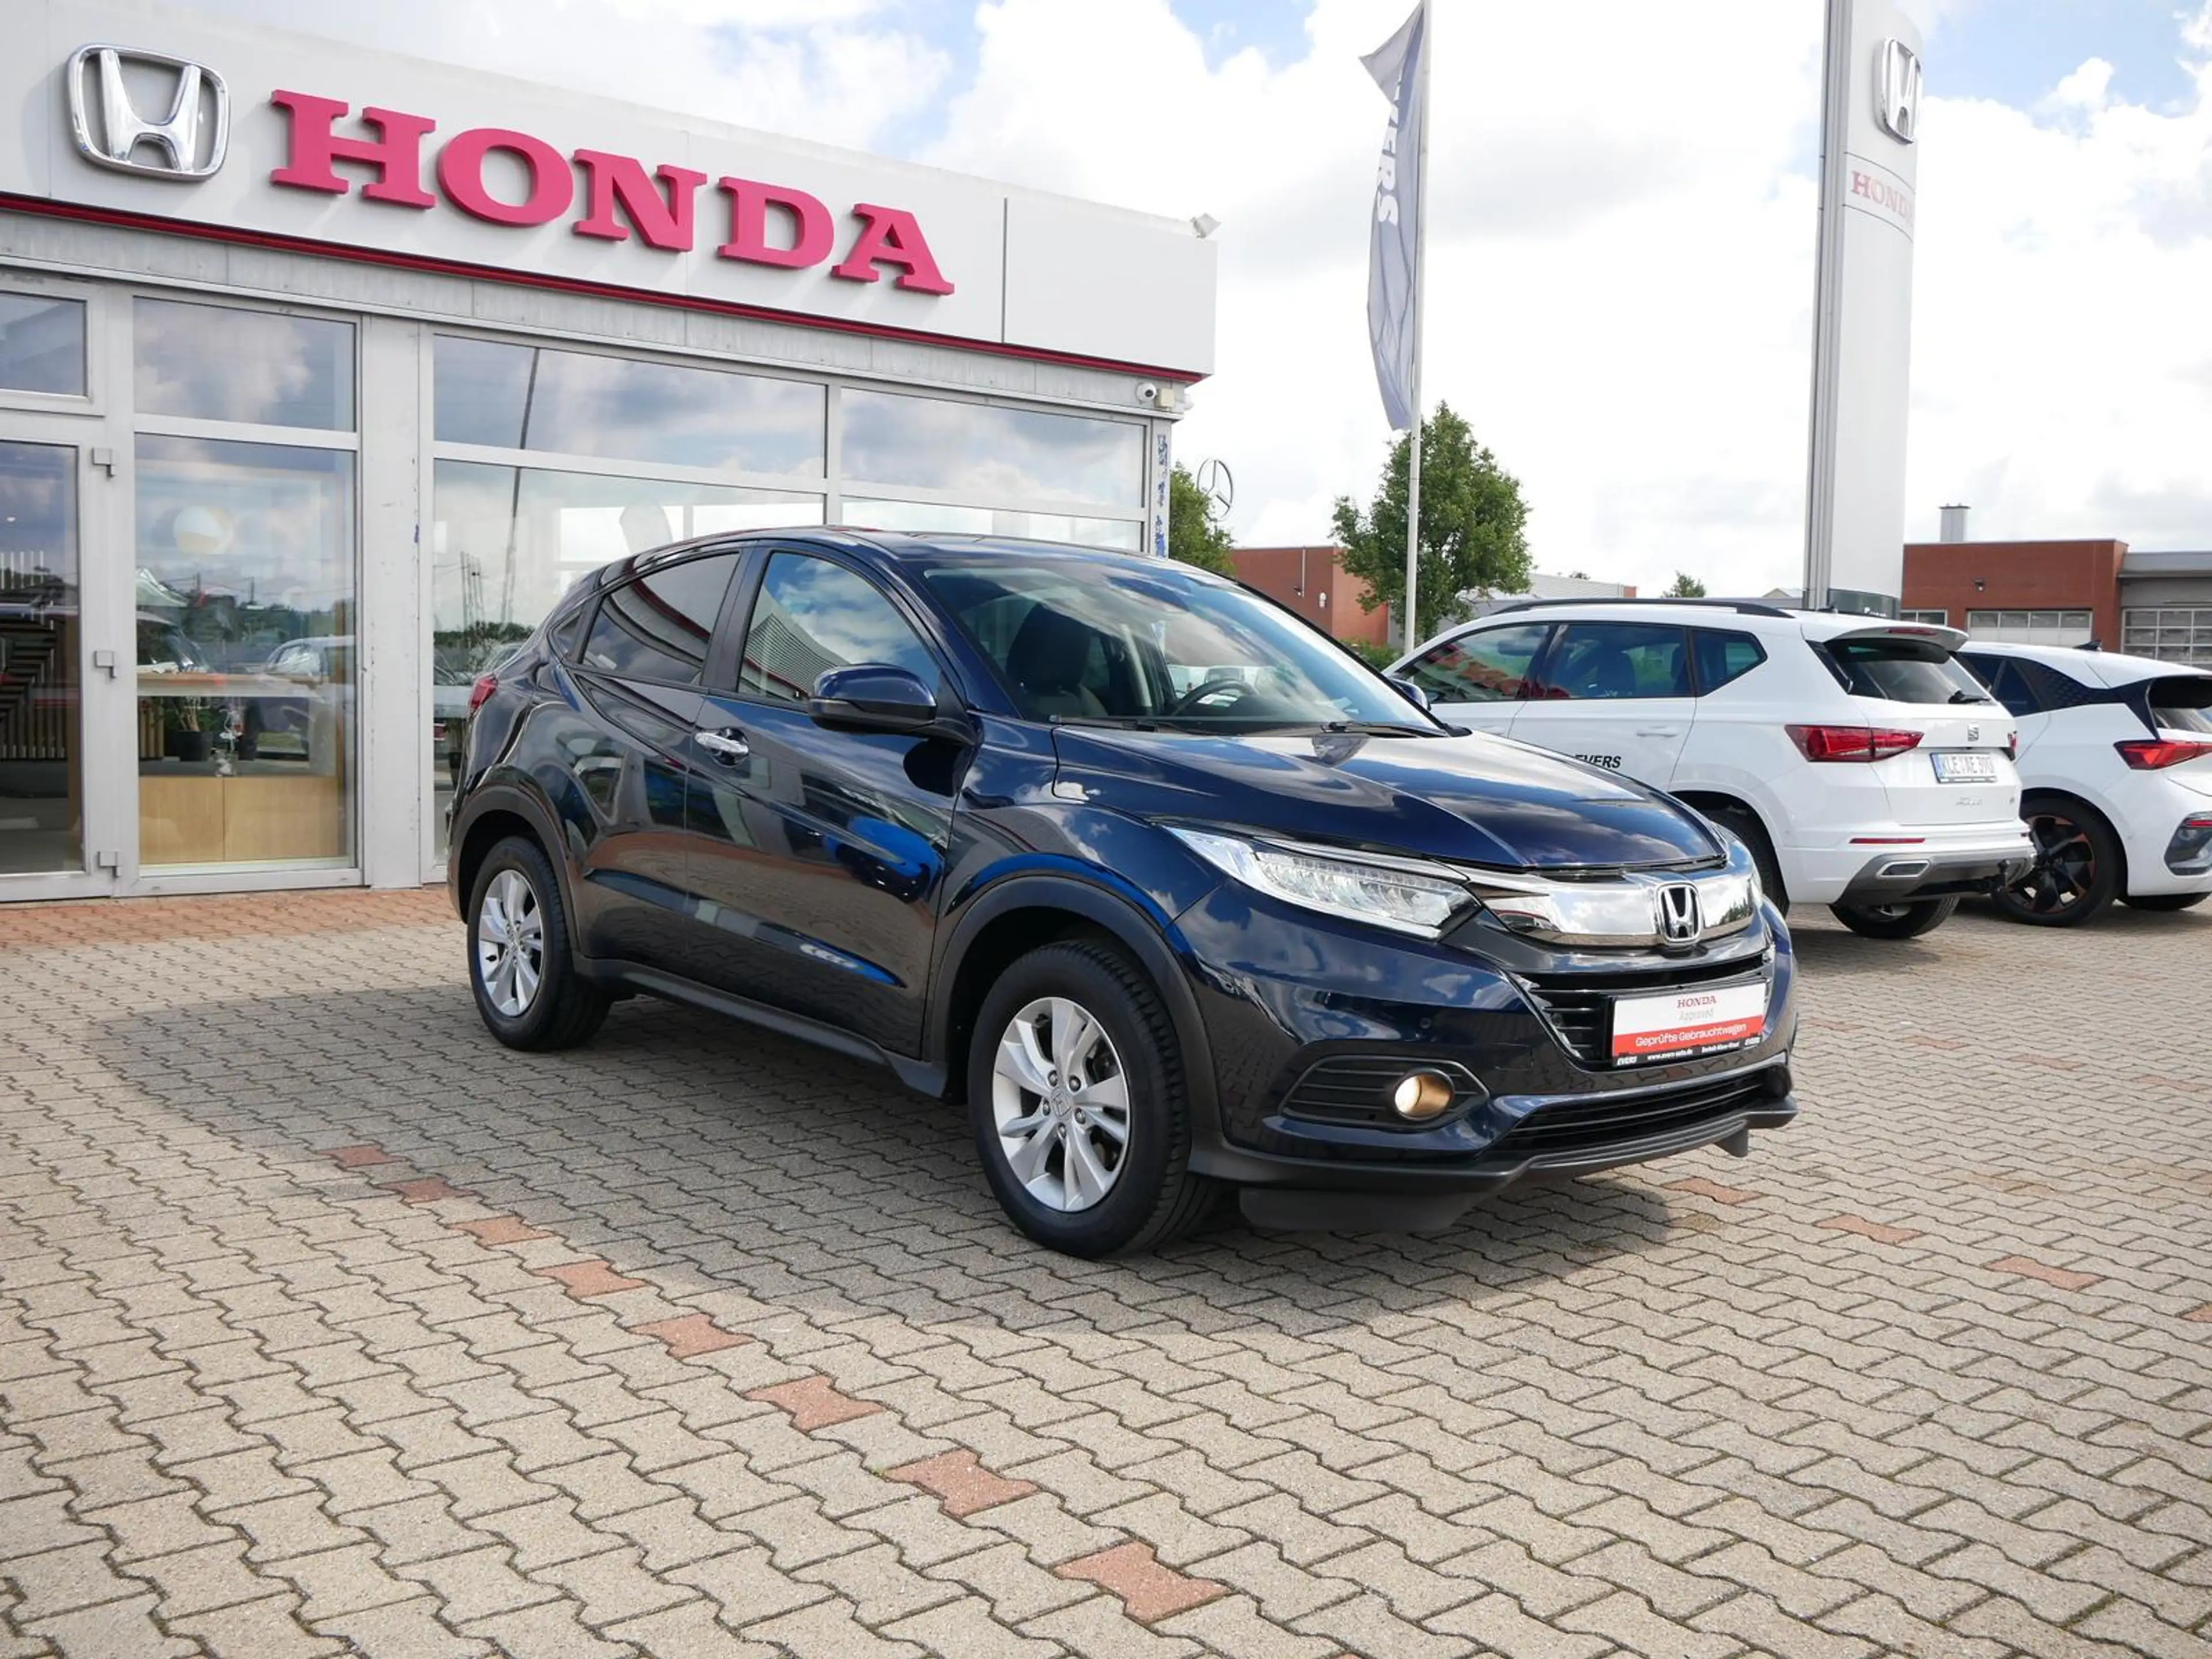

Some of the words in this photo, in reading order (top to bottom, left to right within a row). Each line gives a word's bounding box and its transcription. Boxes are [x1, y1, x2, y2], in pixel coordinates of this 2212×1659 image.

[270, 89, 955, 296] HONDA
[1677, 995, 1717, 1009] HONDA
[1636, 1032, 1678, 1047] Geprüfte
